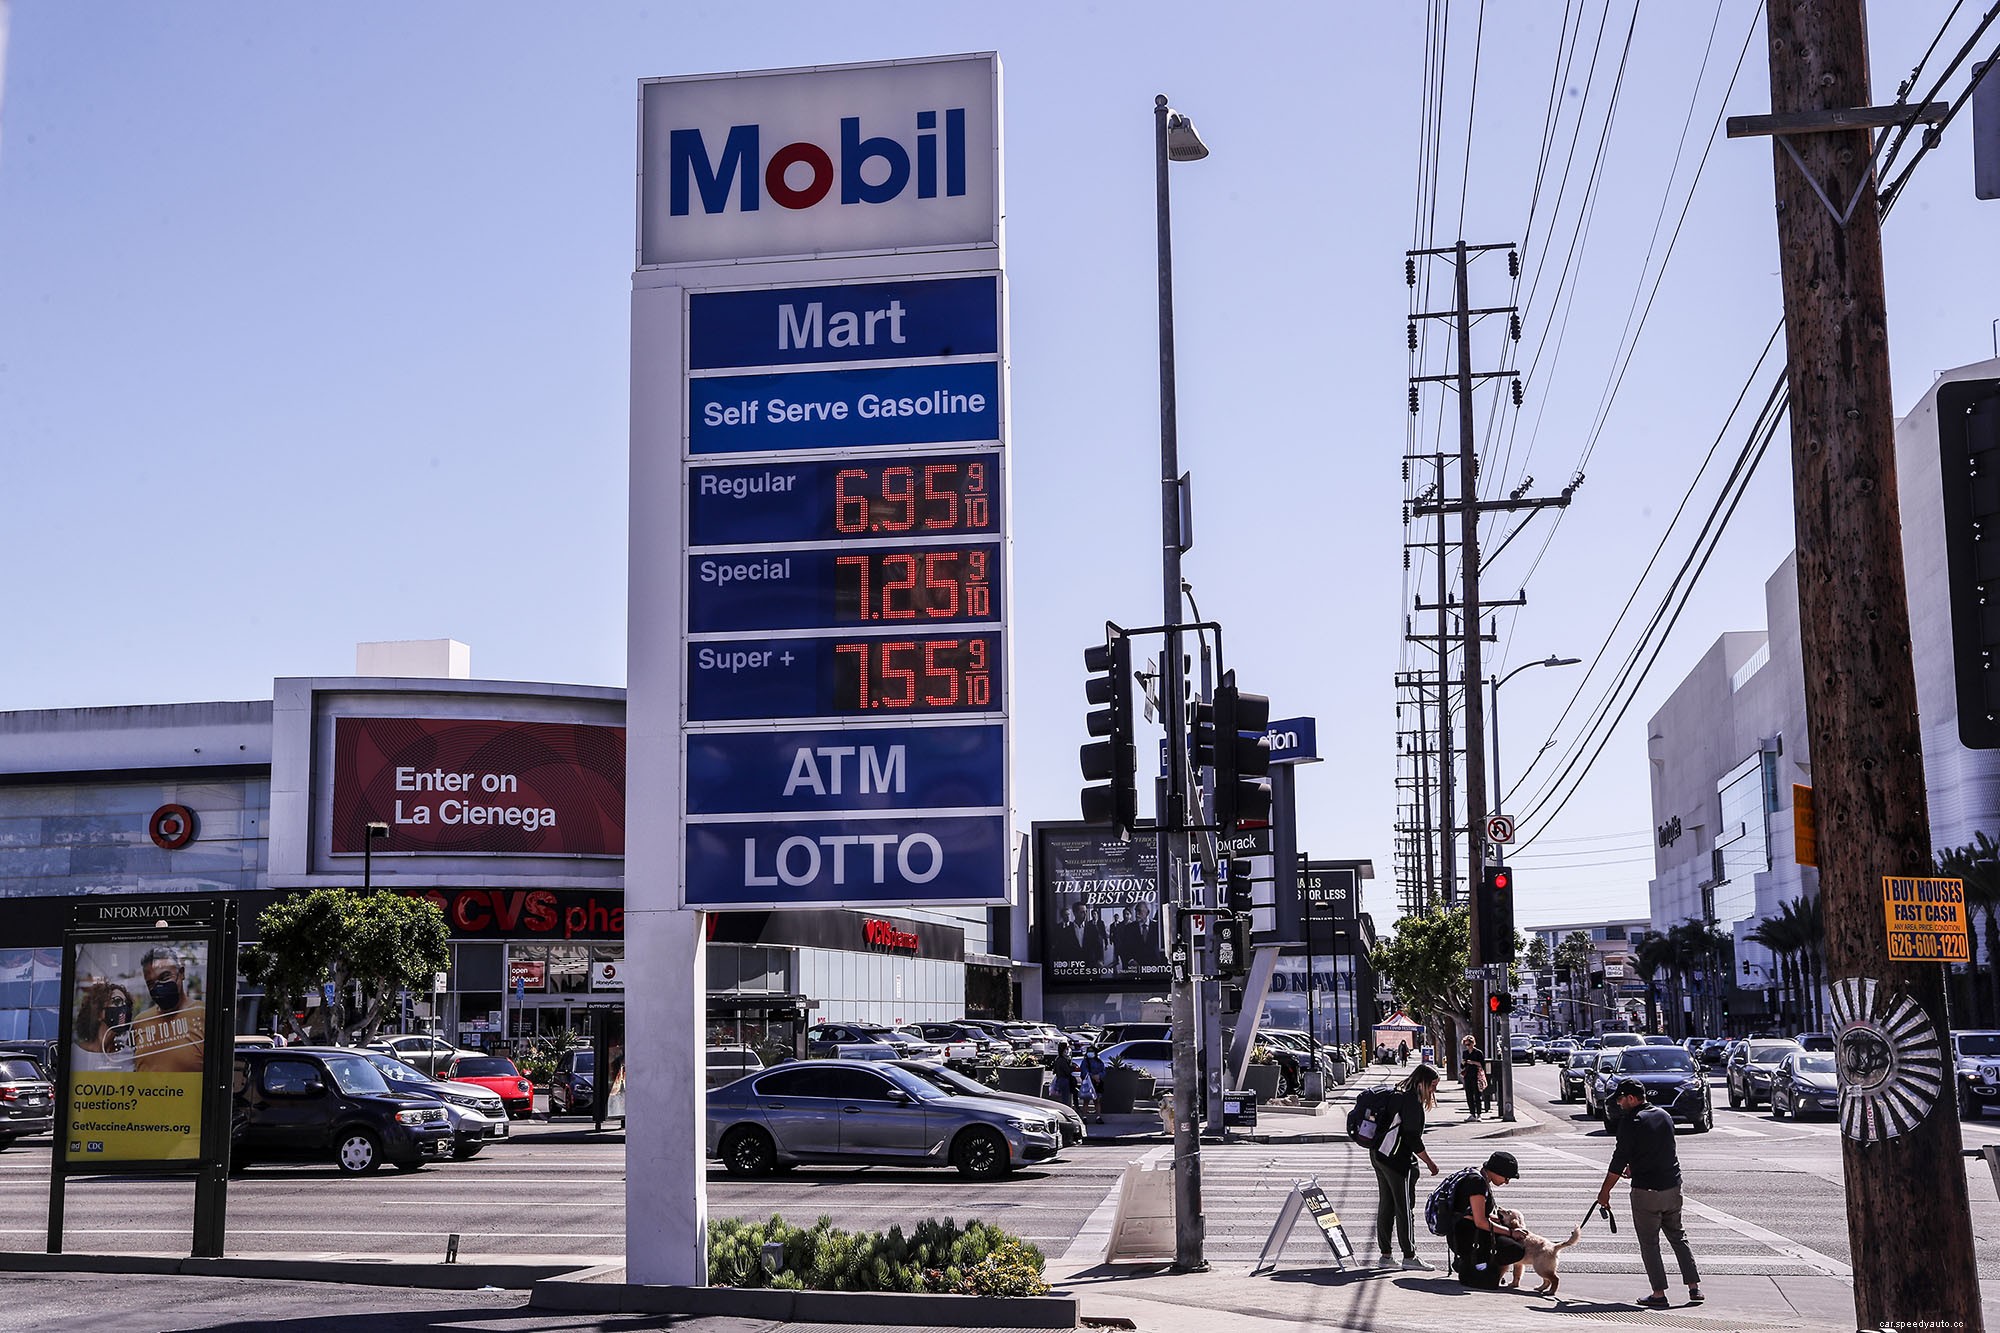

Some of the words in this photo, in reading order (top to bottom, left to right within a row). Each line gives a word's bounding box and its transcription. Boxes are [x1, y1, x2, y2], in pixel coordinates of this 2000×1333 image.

[670, 107, 966, 217] Mobil
[778, 300, 906, 350] Mart
[704, 400, 758, 426] Self
[767, 397, 849, 422] Serve
[857, 390, 985, 418] Gasoline
[700, 472, 796, 499] Regular
[835, 464, 957, 533] 6.95
[700, 558, 791, 586] Special
[835, 552, 958, 620] 7.25
[698, 649, 772, 673] Super
[780, 651, 795, 666] +
[835, 640, 958, 709] 7.55
[396, 767, 474, 791] Enter
[481, 773, 517, 792] on
[782, 745, 906, 796] ATM
[395, 800, 430, 824] La
[439, 800, 556, 831] Cienega
[1232, 834, 1257, 849] rack
[744, 832, 943, 887] LOTTO
[1086, 892, 1124, 904] BEST
[1126, 891, 1157, 903] SHO
[1324, 888, 1346, 900] LESS
[1885, 879, 1890, 900] I
[1892, 879, 1914, 901] BUY
[1917, 880, 1962, 903] HOUSES
[99, 905, 190, 919] INFORMATION
[453, 891, 557, 931] CVS
[565, 898, 624, 939] pha
[1894, 904, 1922, 921] FAST
[1925, 904, 1956, 922] CA$H
[1891, 933, 1966, 957] 626-600-1220
[1292, 972, 1356, 991] NAVY
[127, 1028, 144, 1046] IT'S
[145, 1025, 156, 1042] UP
[159, 1022, 170, 1039] TO
[170, 1017, 188, 1035] YOU
[75, 1085, 135, 1097] COVID-19
[138, 1086, 184, 1097] vaccine
[74, 1099, 138, 1112] questions?
[72, 1121, 191, 1134] GetVaccineAnswers.org
[87, 1142, 102, 1150] CDC
